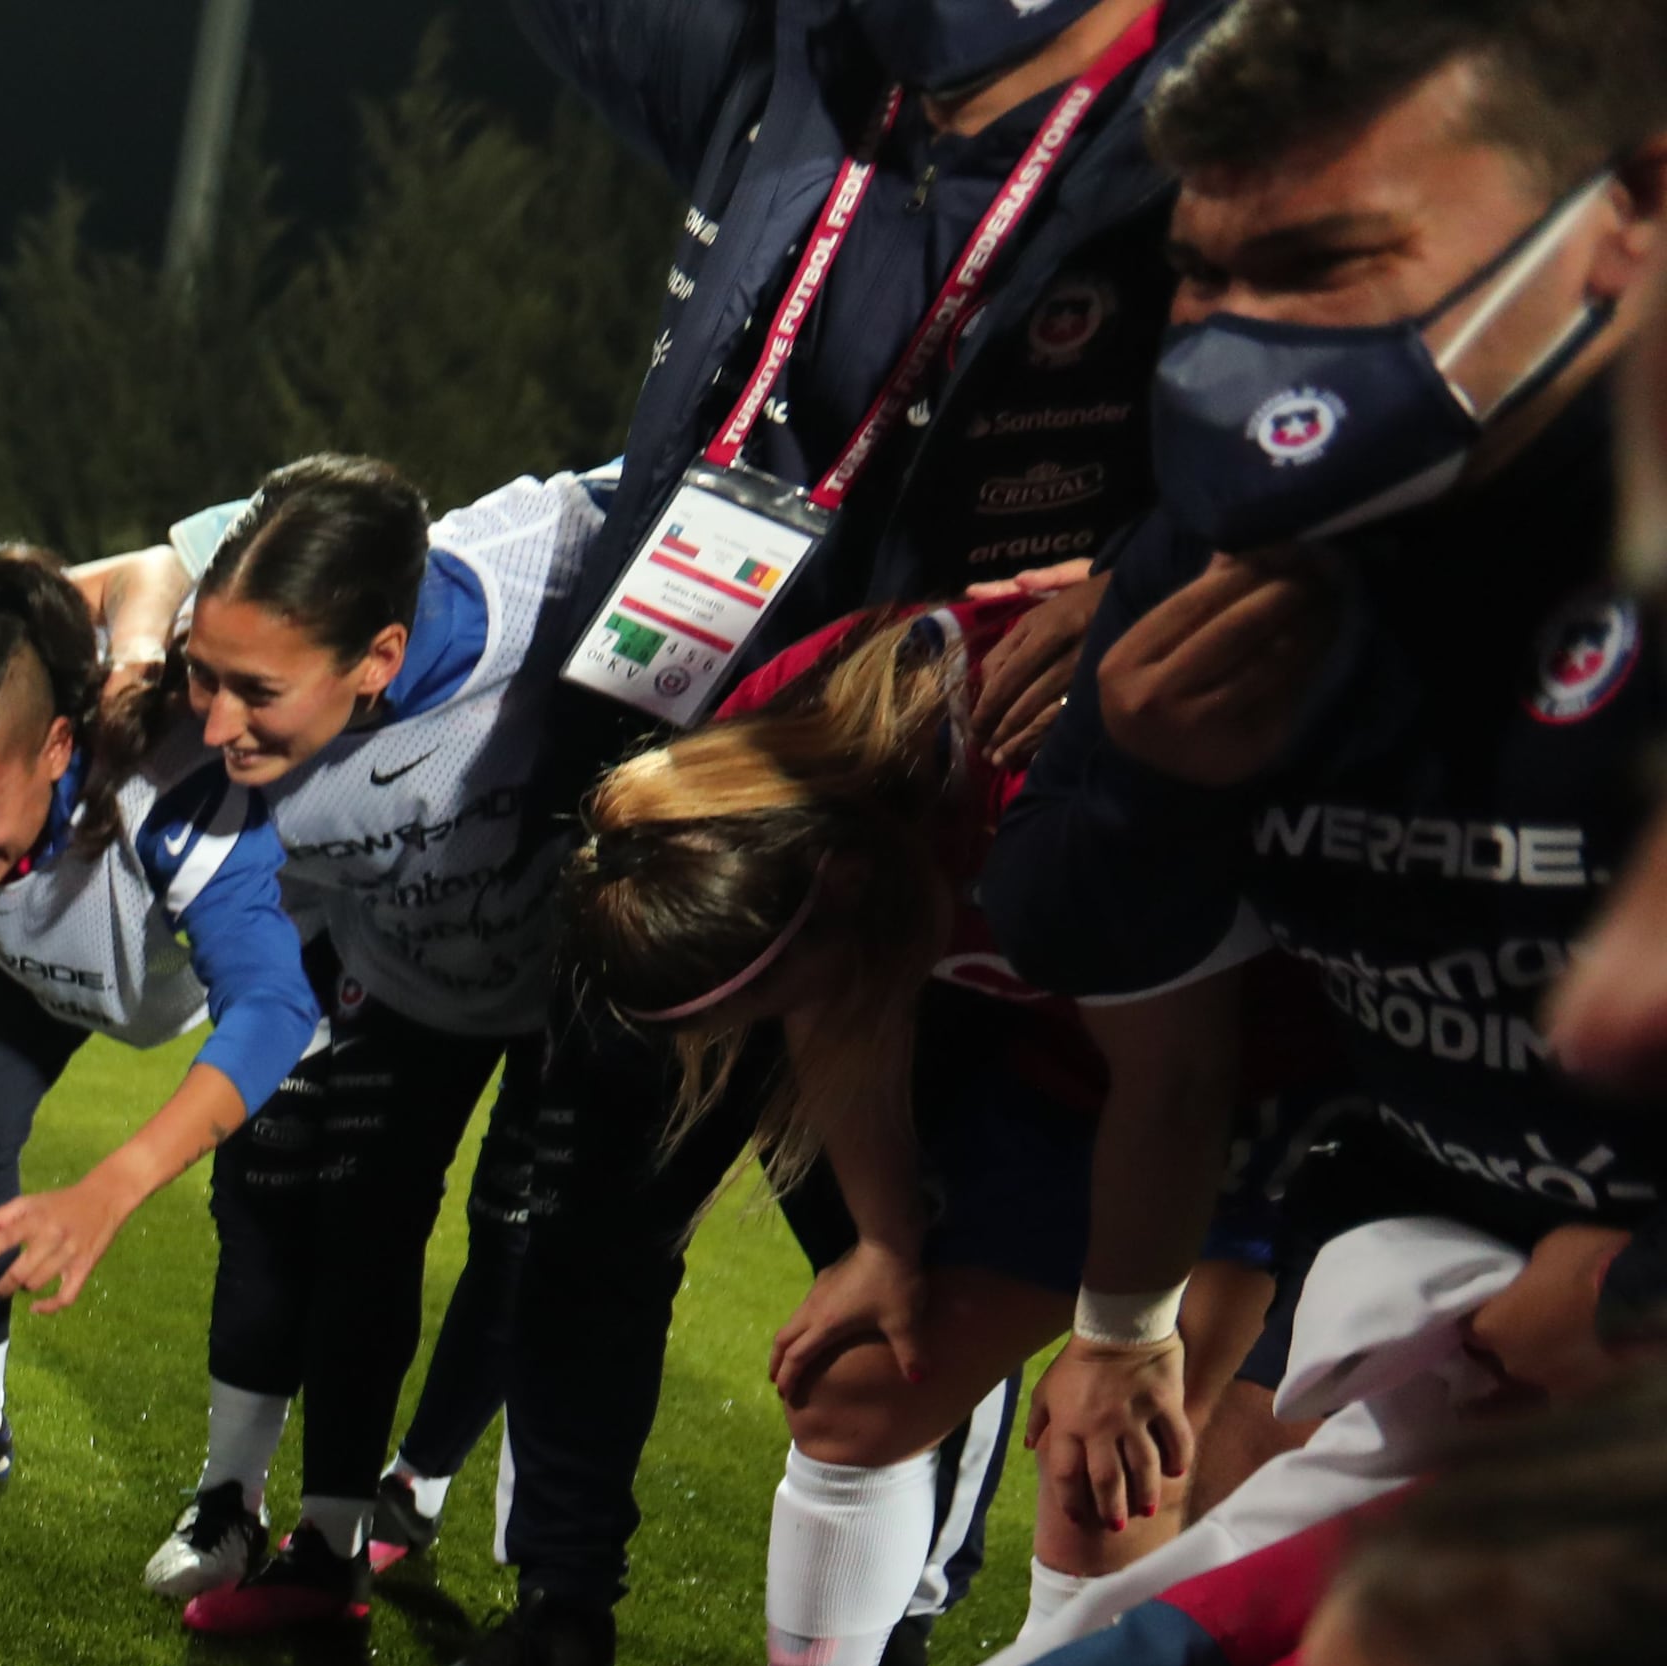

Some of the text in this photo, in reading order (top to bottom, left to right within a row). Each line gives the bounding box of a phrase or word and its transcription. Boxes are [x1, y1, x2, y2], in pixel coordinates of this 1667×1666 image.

[956, 86, 1091, 287] FEDERASYONU
[777, 232, 840, 334] FUTBOL
[993, 401, 1133, 435] Santander
[989, 475, 1087, 506] CRISTAL
[968, 530, 1095, 565] arauco
